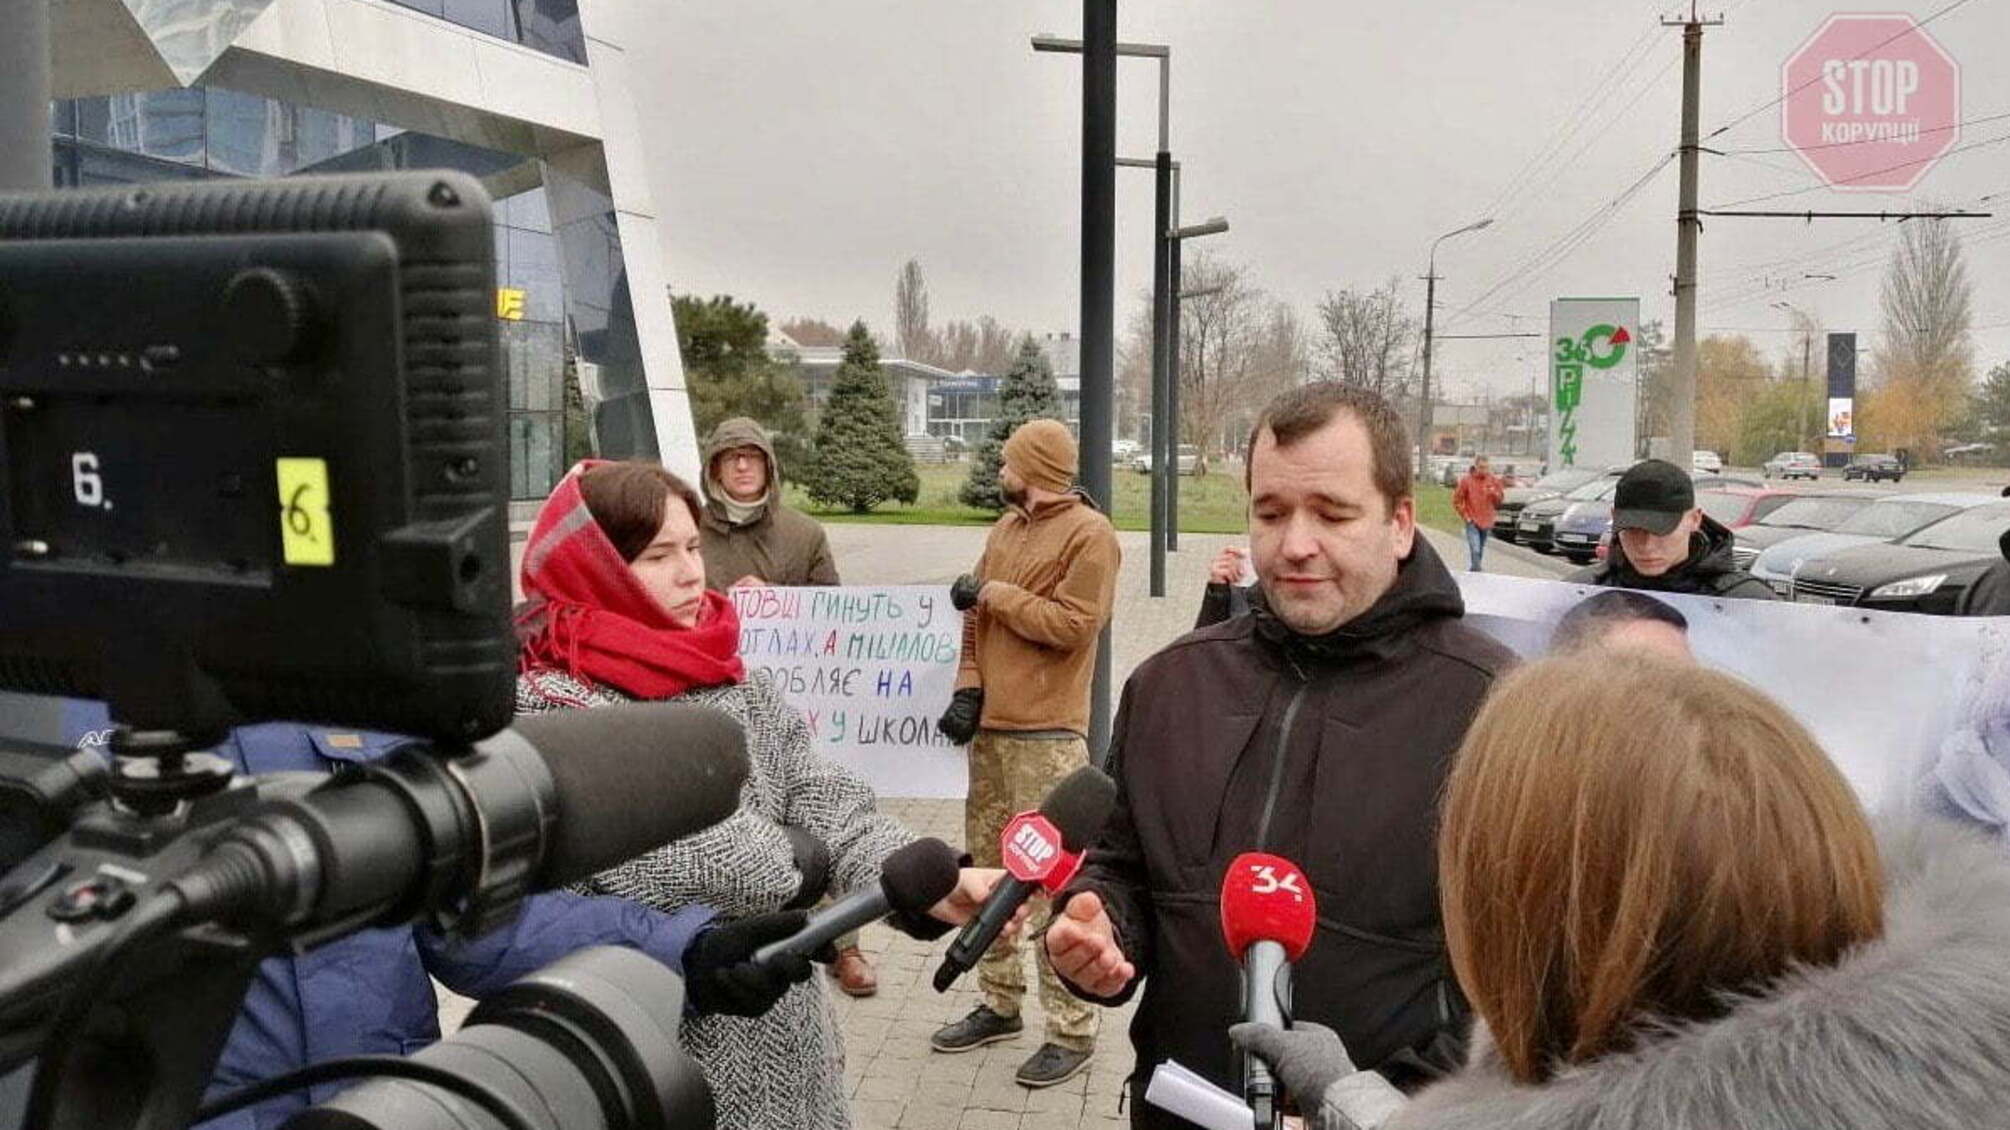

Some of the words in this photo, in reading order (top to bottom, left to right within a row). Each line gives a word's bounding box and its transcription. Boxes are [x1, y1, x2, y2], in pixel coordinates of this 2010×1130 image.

[811, 590, 903, 625] ГИНУТЬ
[876, 668, 913, 699] НА
[857, 713, 952, 748] ШКОЛА
[1013, 822, 1056, 864] STOP
